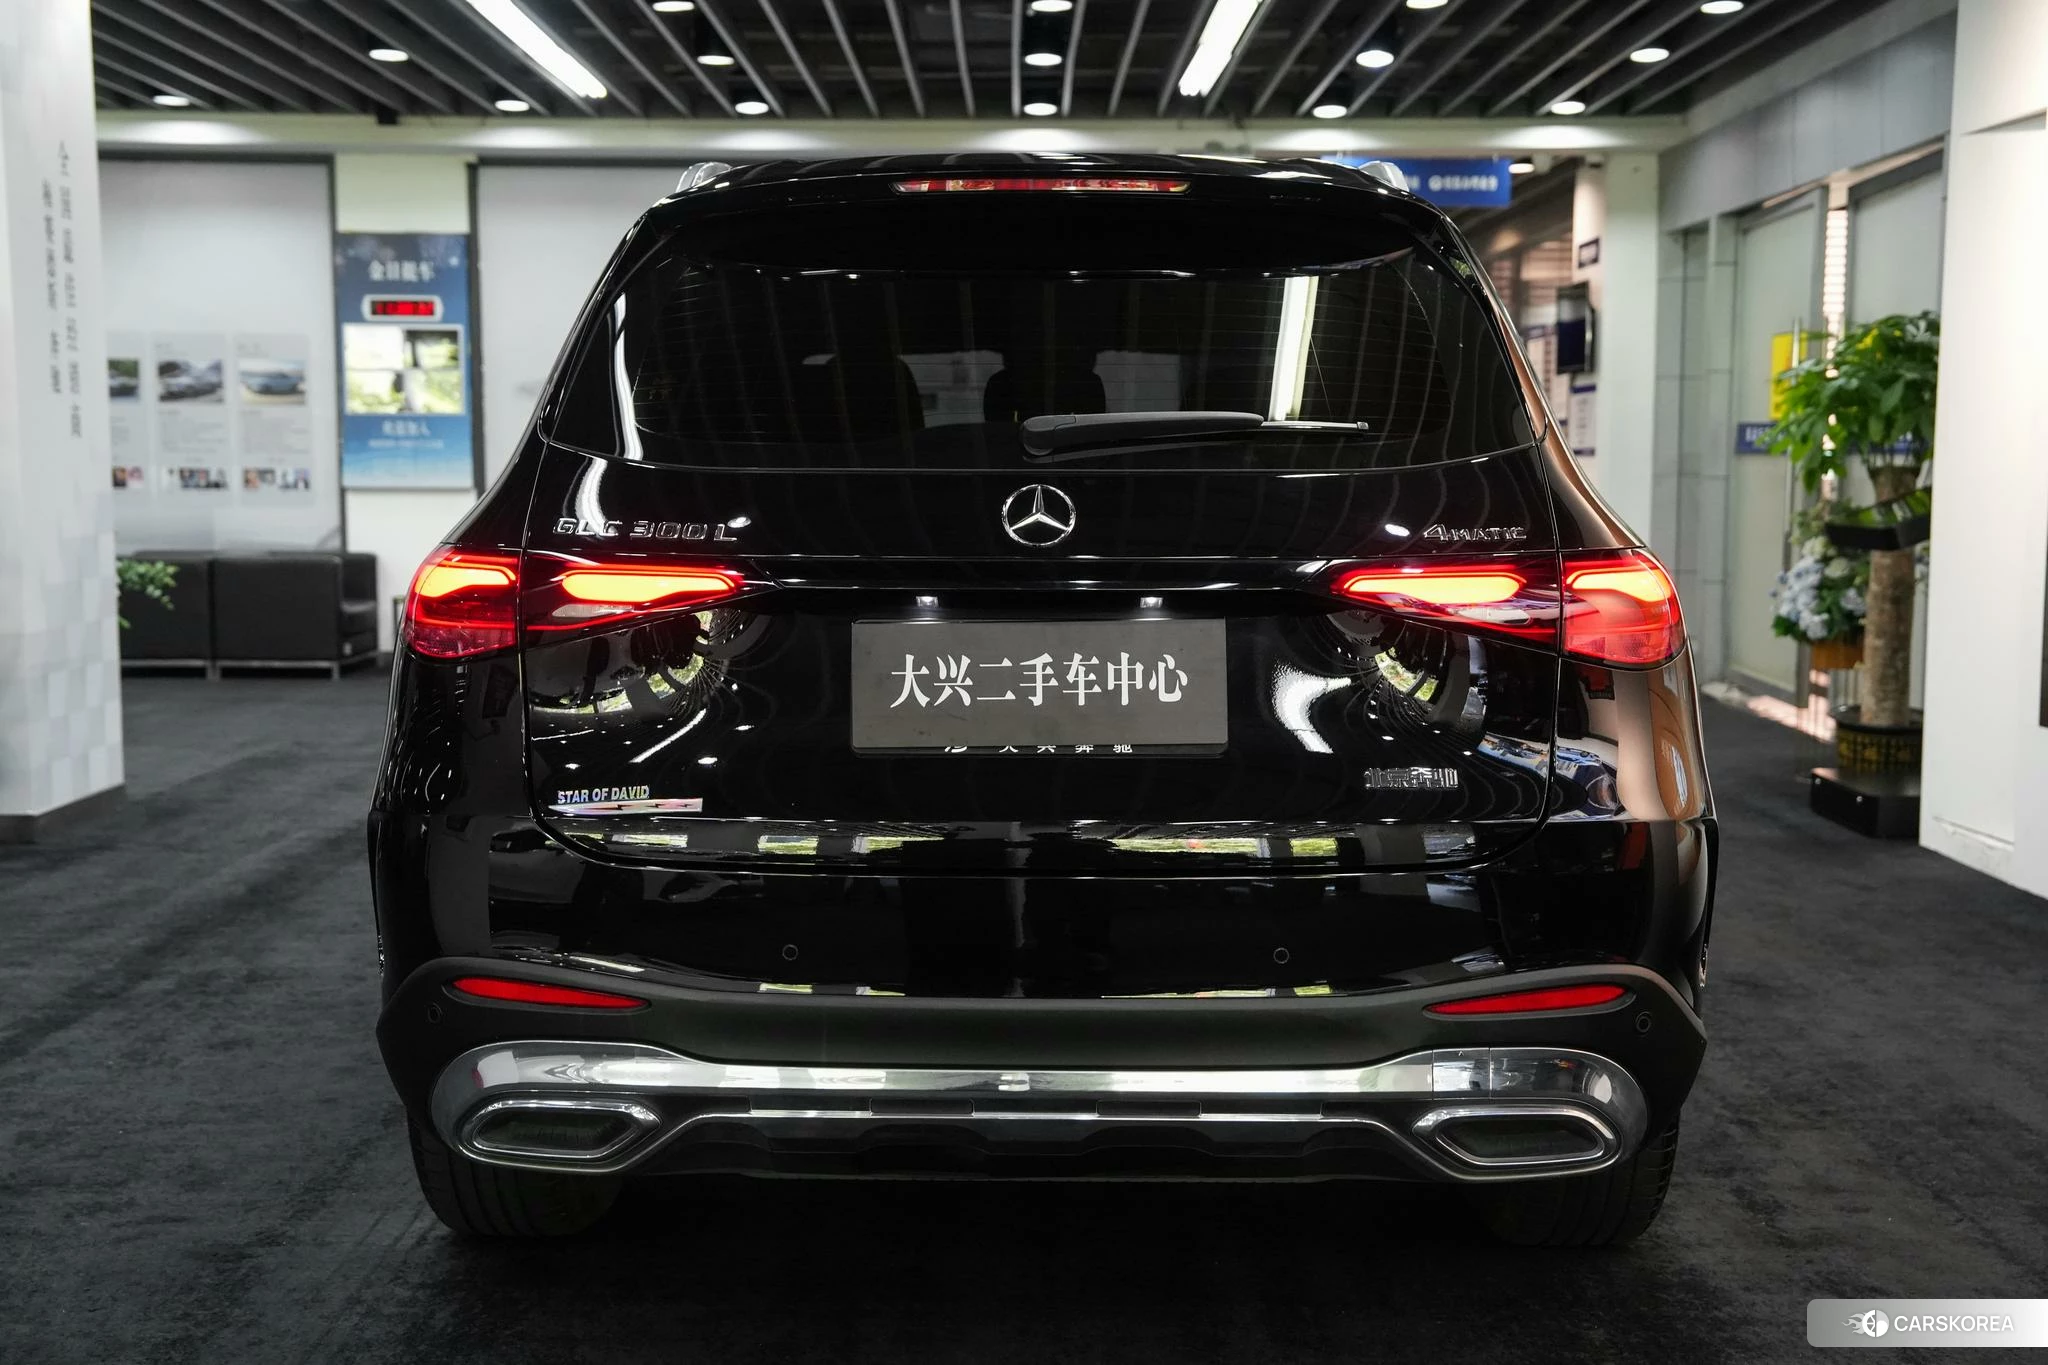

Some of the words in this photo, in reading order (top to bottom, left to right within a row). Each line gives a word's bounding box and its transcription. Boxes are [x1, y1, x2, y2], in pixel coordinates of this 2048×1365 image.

[553, 517, 623, 537] GLC
[630, 520, 708, 540] 300
[714, 523, 738, 541] L
[1423, 523, 1527, 541] 4MATIC
[889, 651, 1189, 709] 大兴二手车中心
[557, 789, 589, 804] STAR
[592, 787, 609, 802] OF
[611, 785, 650, 800] DAVID
